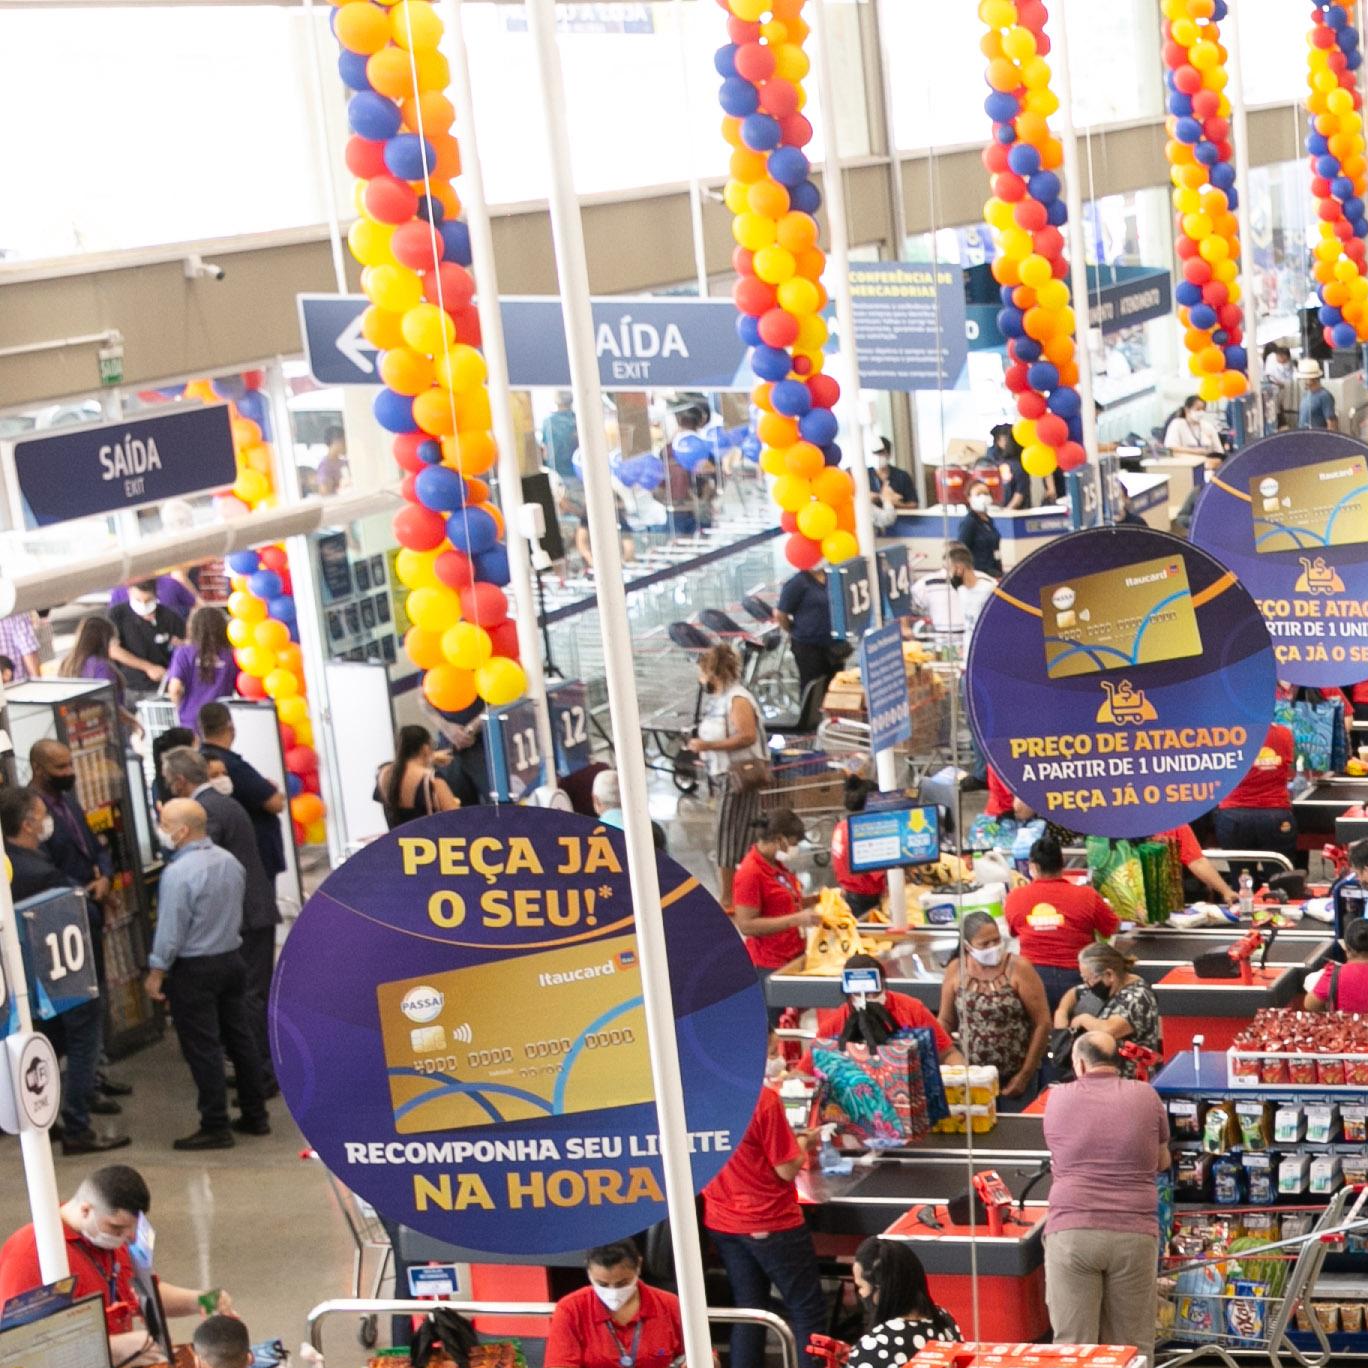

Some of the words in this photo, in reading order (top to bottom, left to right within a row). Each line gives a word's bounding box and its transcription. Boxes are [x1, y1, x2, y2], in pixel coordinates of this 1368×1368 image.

[935, 272, 953, 285] DE
[596, 314, 689, 359] AÍDA
[613, 361, 651, 379] EXIT
[99, 433, 162, 481] SAÍDA
[125, 477, 145, 497] EXIT
[889, 566, 909, 599] 14
[1125, 570, 1168, 587] Itaucard
[850, 578, 870, 616] 13
[1293, 600, 1321, 617] DE
[1265, 622, 1302, 636] RTIR
[1304, 623, 1324, 636] DE
[1328, 623, 1337, 636] 1
[1305, 642, 1328, 662] JÁ
[1331, 647, 1346, 662] O
[562, 709, 585, 747] 12
[1010, 735, 1091, 762] PREÇO
[1096, 733, 1129, 753] DE
[1134, 726, 1246, 750] ATACADO
[513, 728, 539, 768] 11
[1022, 763, 1037, 782] A
[1040, 760, 1106, 780] PARTIR
[1109, 757, 1133, 775] DE
[1139, 756, 1148, 774] 1
[1152, 750, 1243, 773] UNIDADE¹
[1047, 789, 1109, 812] PEÇA
[1111, 782, 1141, 807] JÁ
[1143, 786, 1161, 804] O
[399, 836, 544, 885] PEÇA
[557, 827, 622, 874] JÁ
[427, 890, 466, 928] O
[45, 923, 84, 980] 10
[538, 959, 616, 988] Itaucard
[345, 1138, 560, 1164] RECOMPONHA
[567, 1136, 621, 1158] SEU
[630, 1131, 732, 1156] LIITE
[414, 1174, 495, 1211] NA
[507, 1168, 666, 1209] HORA
